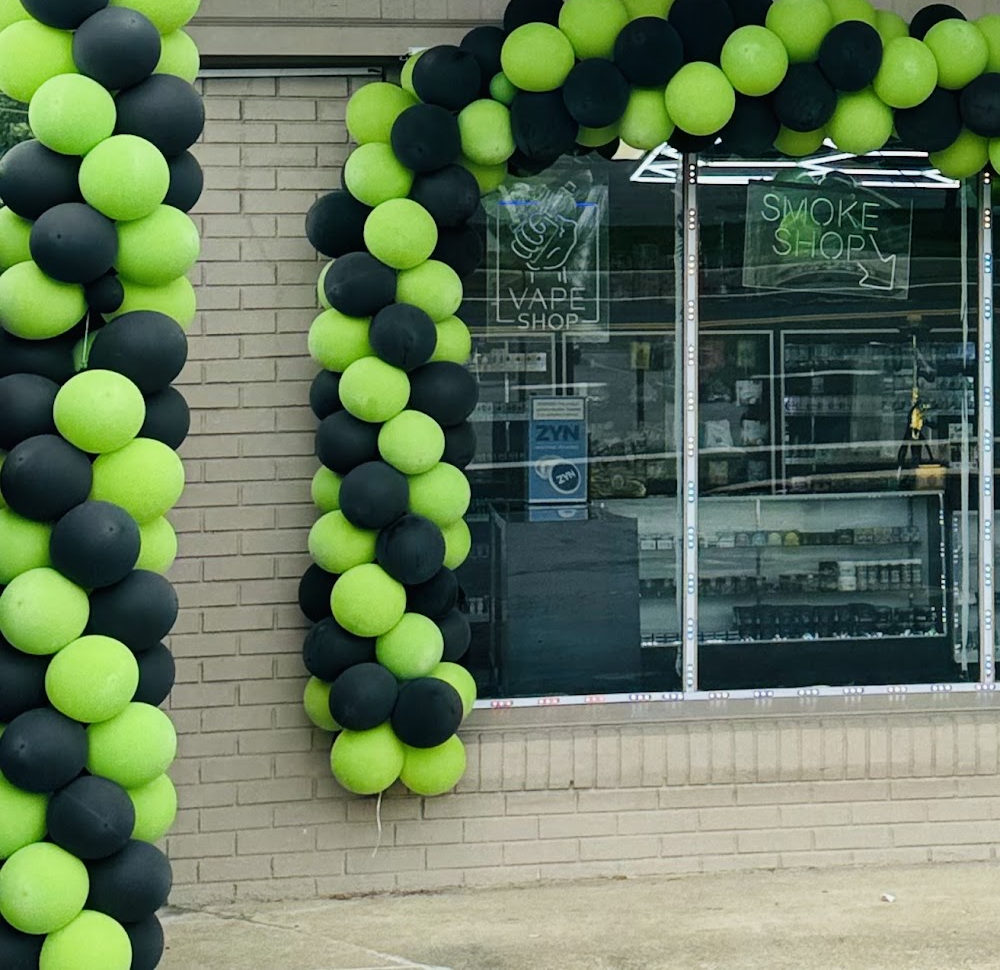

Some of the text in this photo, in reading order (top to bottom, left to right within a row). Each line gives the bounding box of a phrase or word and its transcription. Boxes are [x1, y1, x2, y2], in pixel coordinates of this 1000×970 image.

[761, 193, 881, 231] SMOKE
[772, 228, 866, 262] SHOP
[508, 287, 586, 310] VAPE
[517, 312, 579, 330] SHOP
[535, 425, 580, 441] ZYN
[556, 469, 577, 485] ZYN
